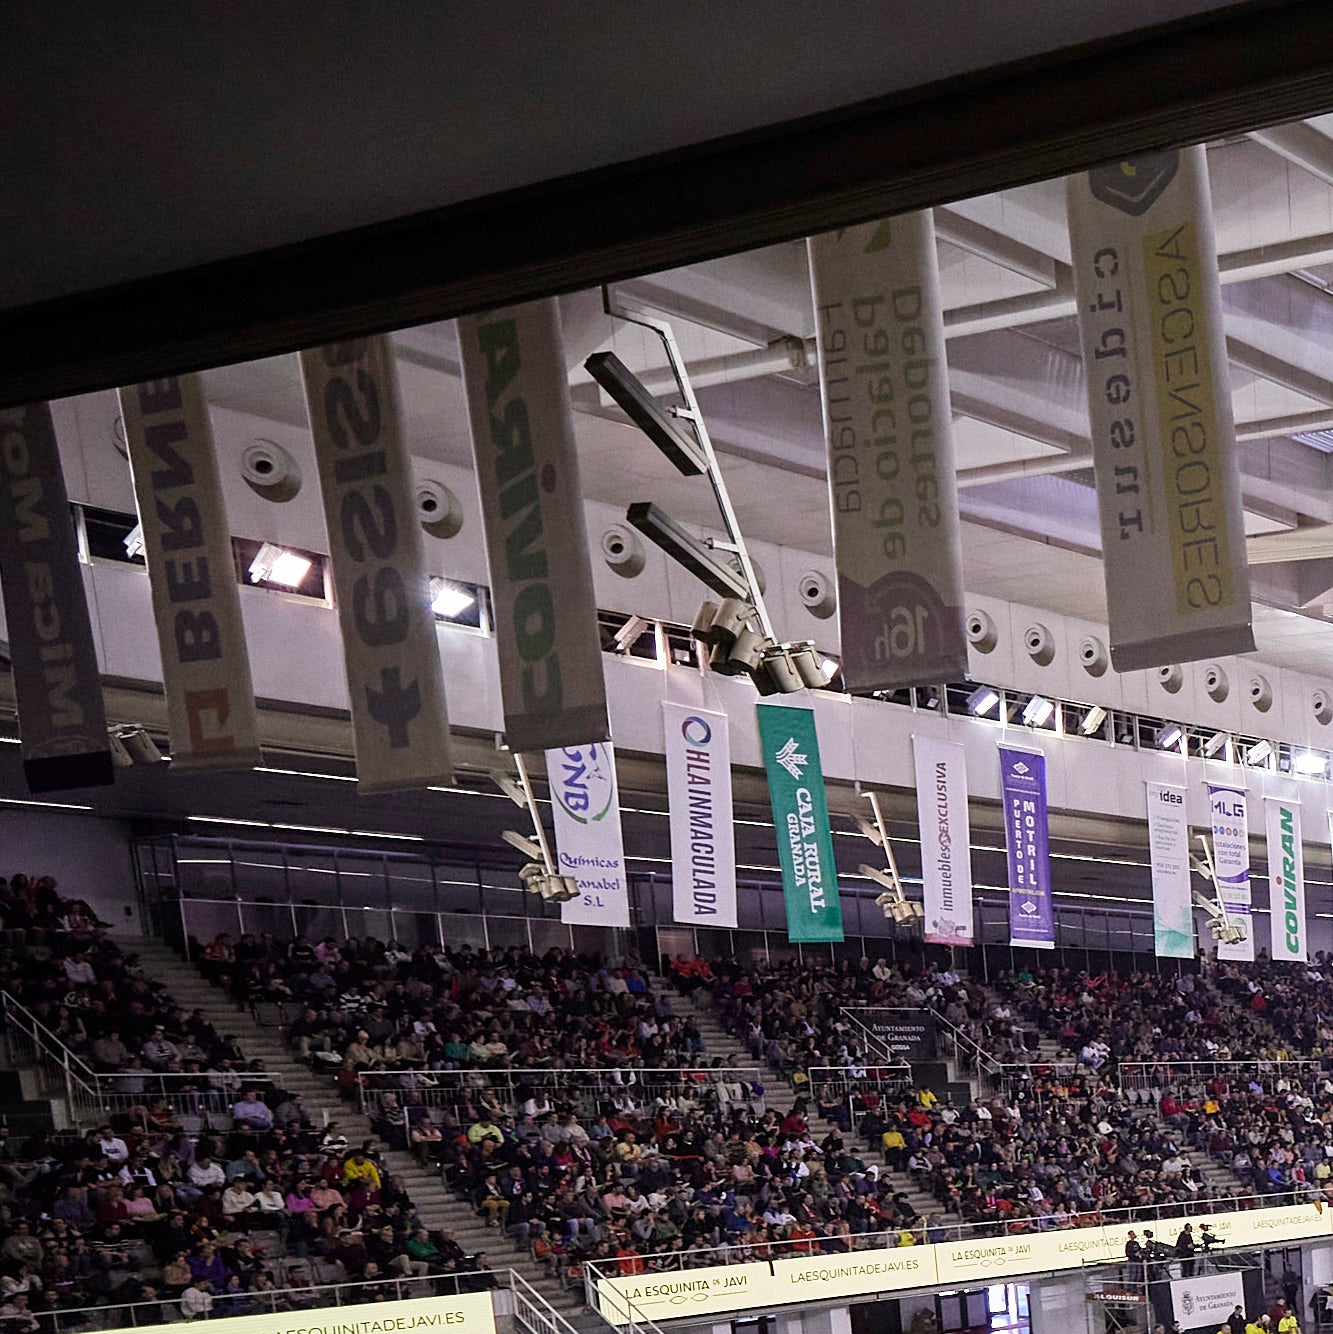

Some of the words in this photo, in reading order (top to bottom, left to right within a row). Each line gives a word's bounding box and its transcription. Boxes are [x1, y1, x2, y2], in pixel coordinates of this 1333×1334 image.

[796, 787, 815, 839] CAJA
[1013, 799, 1024, 860] PUERTO
[1023, 800, 1038, 885] MOTRIL
[786, 813, 807, 887] GRANADA
[804, 840, 826, 914] RURAL
[1017, 864, 1025, 884] DE
[1276, 806, 1299, 954] COVIRAN
[645, 1279, 711, 1299] ESQUINITA
[723, 1274, 748, 1289] JAVI
[790, 1258, 920, 1285] LAESQUINITADEJAVI.ES
